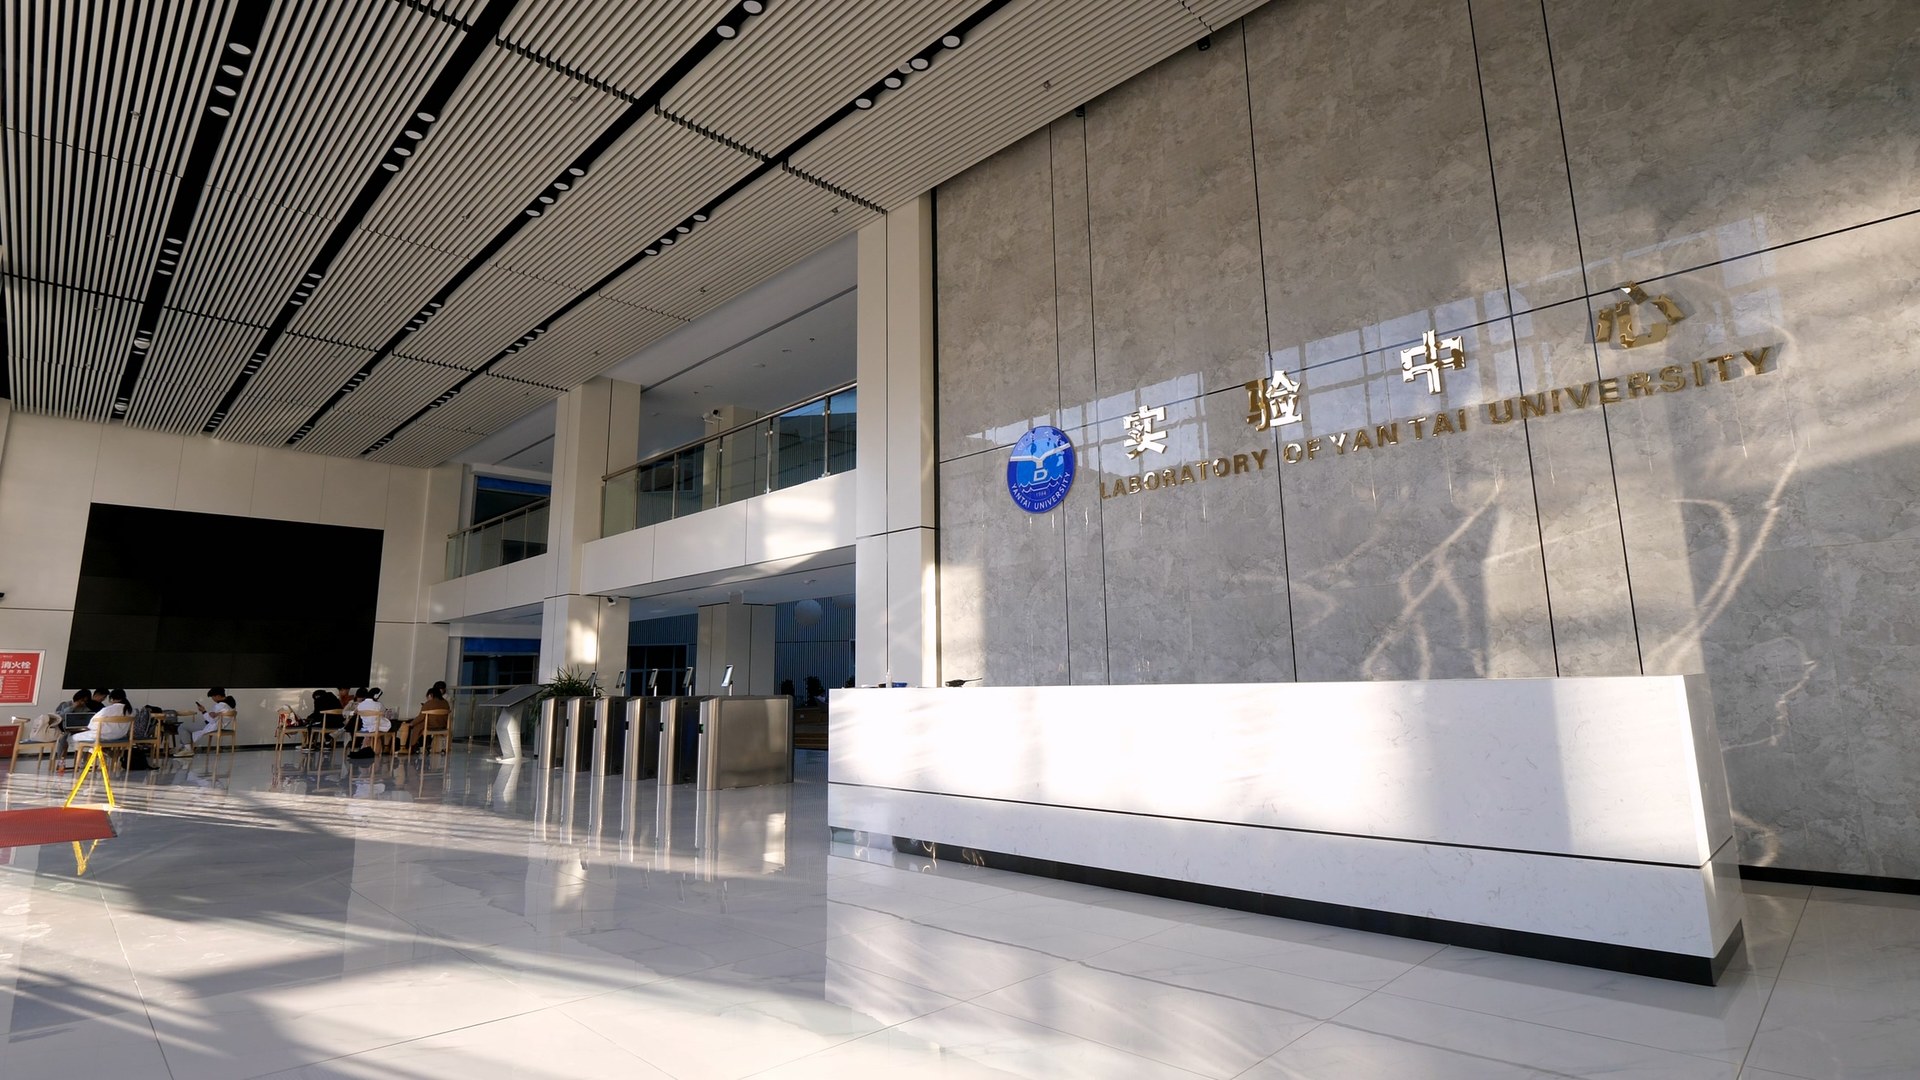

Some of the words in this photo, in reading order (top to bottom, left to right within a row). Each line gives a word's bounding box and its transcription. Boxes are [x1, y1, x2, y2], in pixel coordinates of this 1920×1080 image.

[1100, 449, 1268, 499] LABORATORY
[1283, 437, 1321, 464] OF
[1489, 346, 1772, 425] UNIVERSITY
[1123, 281, 1686, 459] 实验中心
[1011, 483, 1031, 508] YANTAI
[1034, 471, 1071, 510] UNIVERSITY
